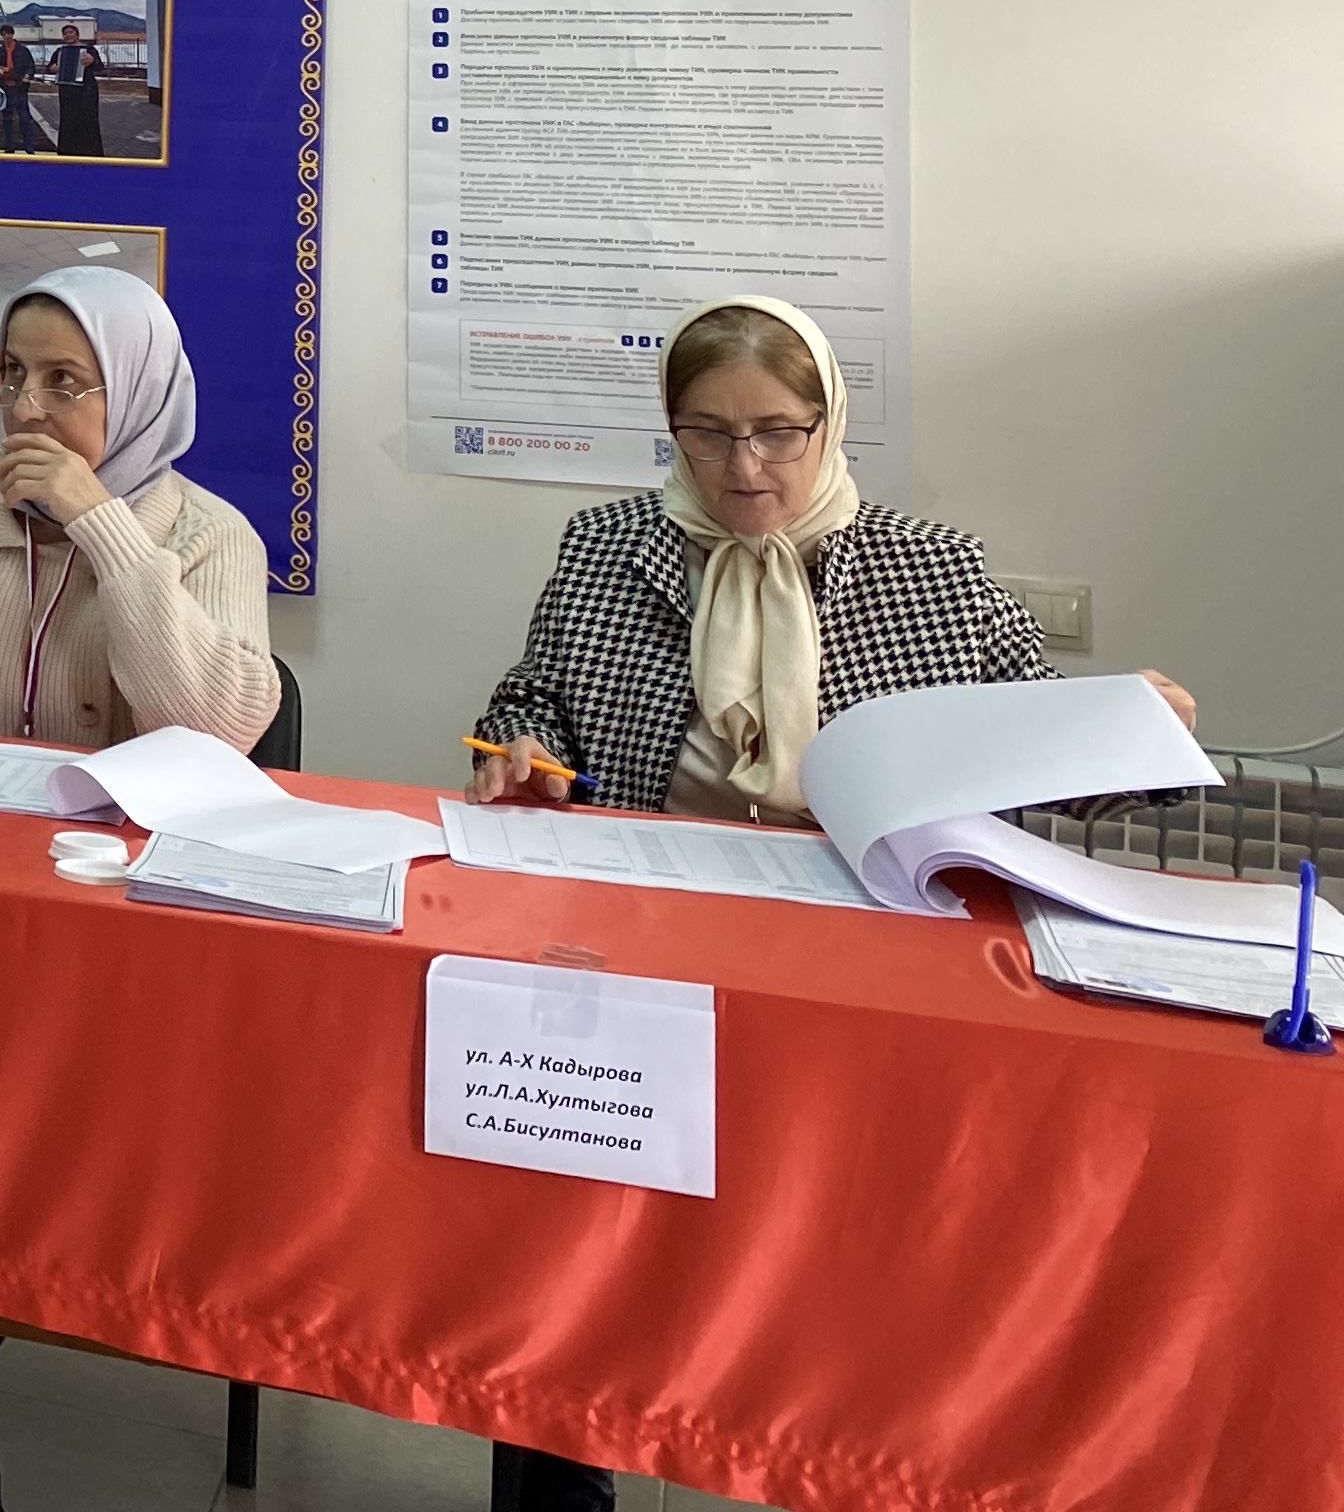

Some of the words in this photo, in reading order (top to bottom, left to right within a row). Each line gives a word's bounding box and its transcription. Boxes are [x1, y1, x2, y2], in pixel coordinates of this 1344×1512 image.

[488, 436, 496, 446] 8
[498, 437, 523, 447] 800
[526, 439, 551, 449] 200
[554, 440, 571, 450] 00
[574, 442, 591, 451] 20
[465, 1049, 493, 1065] ул.
[499, 1050, 535, 1070] А-Х
[539, 1056, 643, 1084] Кадырова
[465, 1081, 654, 1120] ул.Л.А.Хултыгова
[465, 1112, 643, 1152] С.А.Бисултанова
